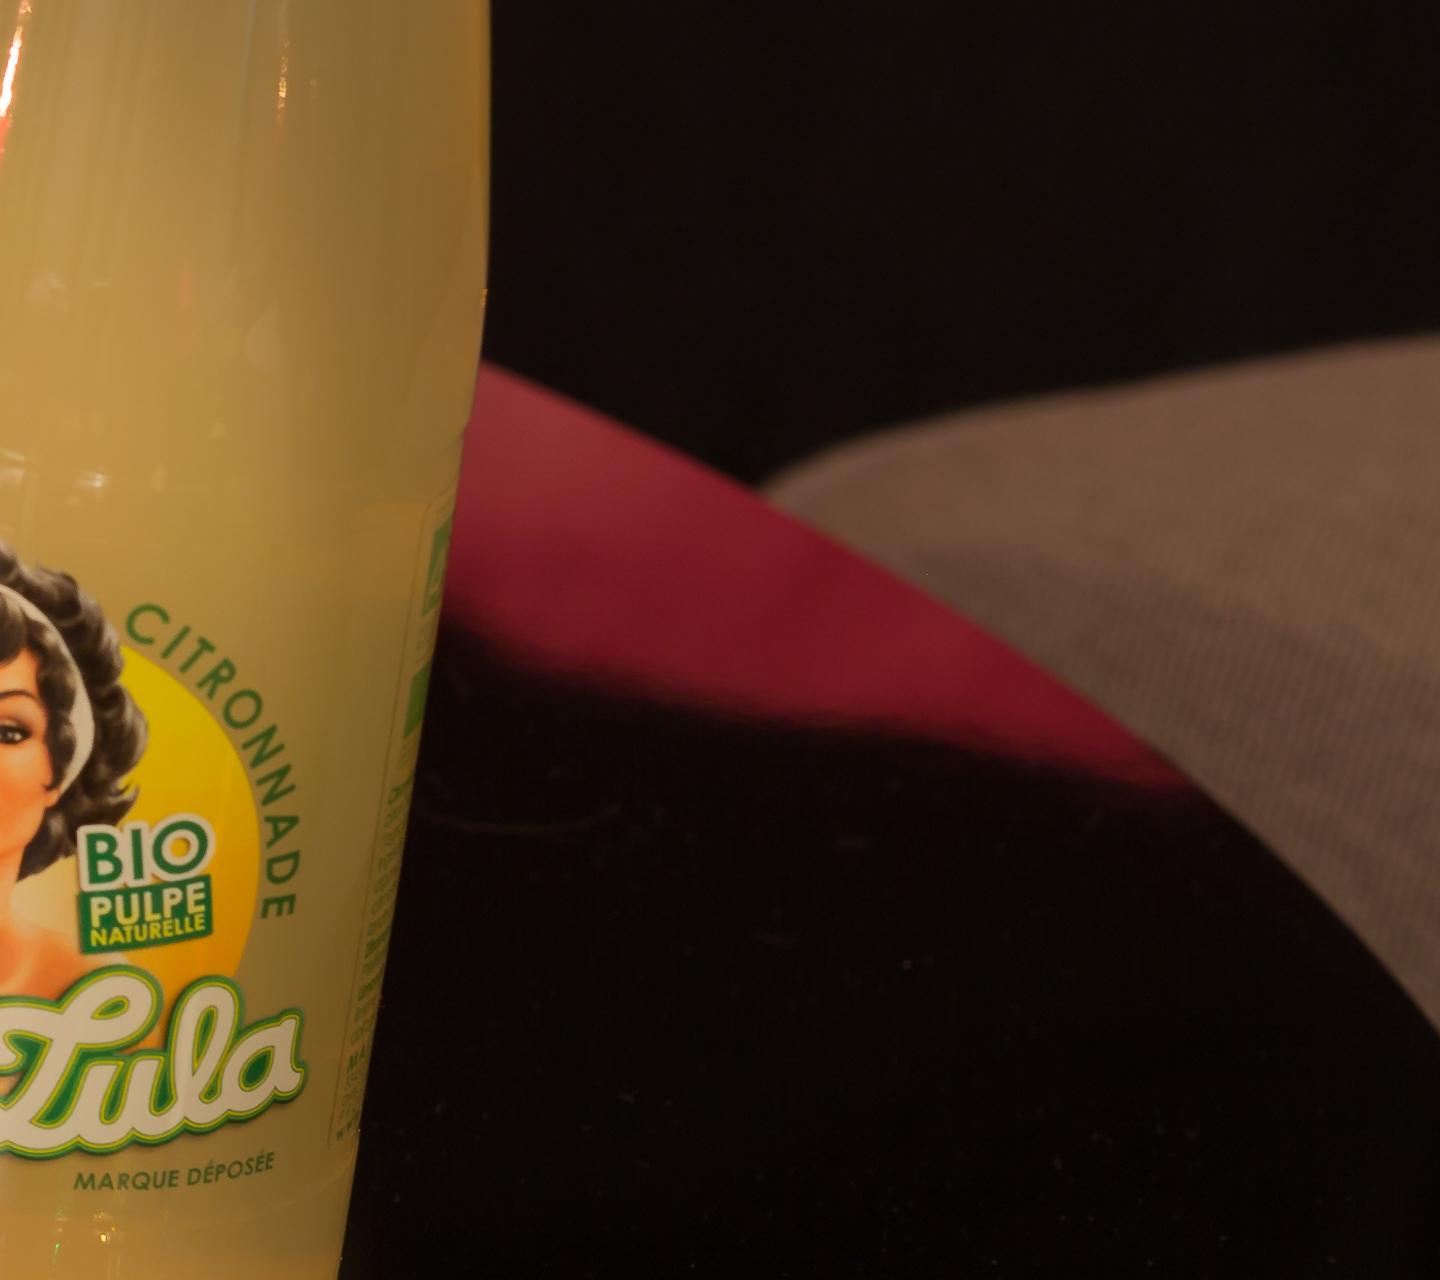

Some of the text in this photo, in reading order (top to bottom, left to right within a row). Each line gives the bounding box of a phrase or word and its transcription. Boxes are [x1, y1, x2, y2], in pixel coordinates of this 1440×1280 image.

[125, 604, 302, 920] CITRONNADE
[84, 818, 210, 886] BIO
[89, 880, 206, 929] PULPE
[89, 912, 206, 947] NATURELLE
[73, 1147, 276, 1191] MARQUE DÉPOSÉE
